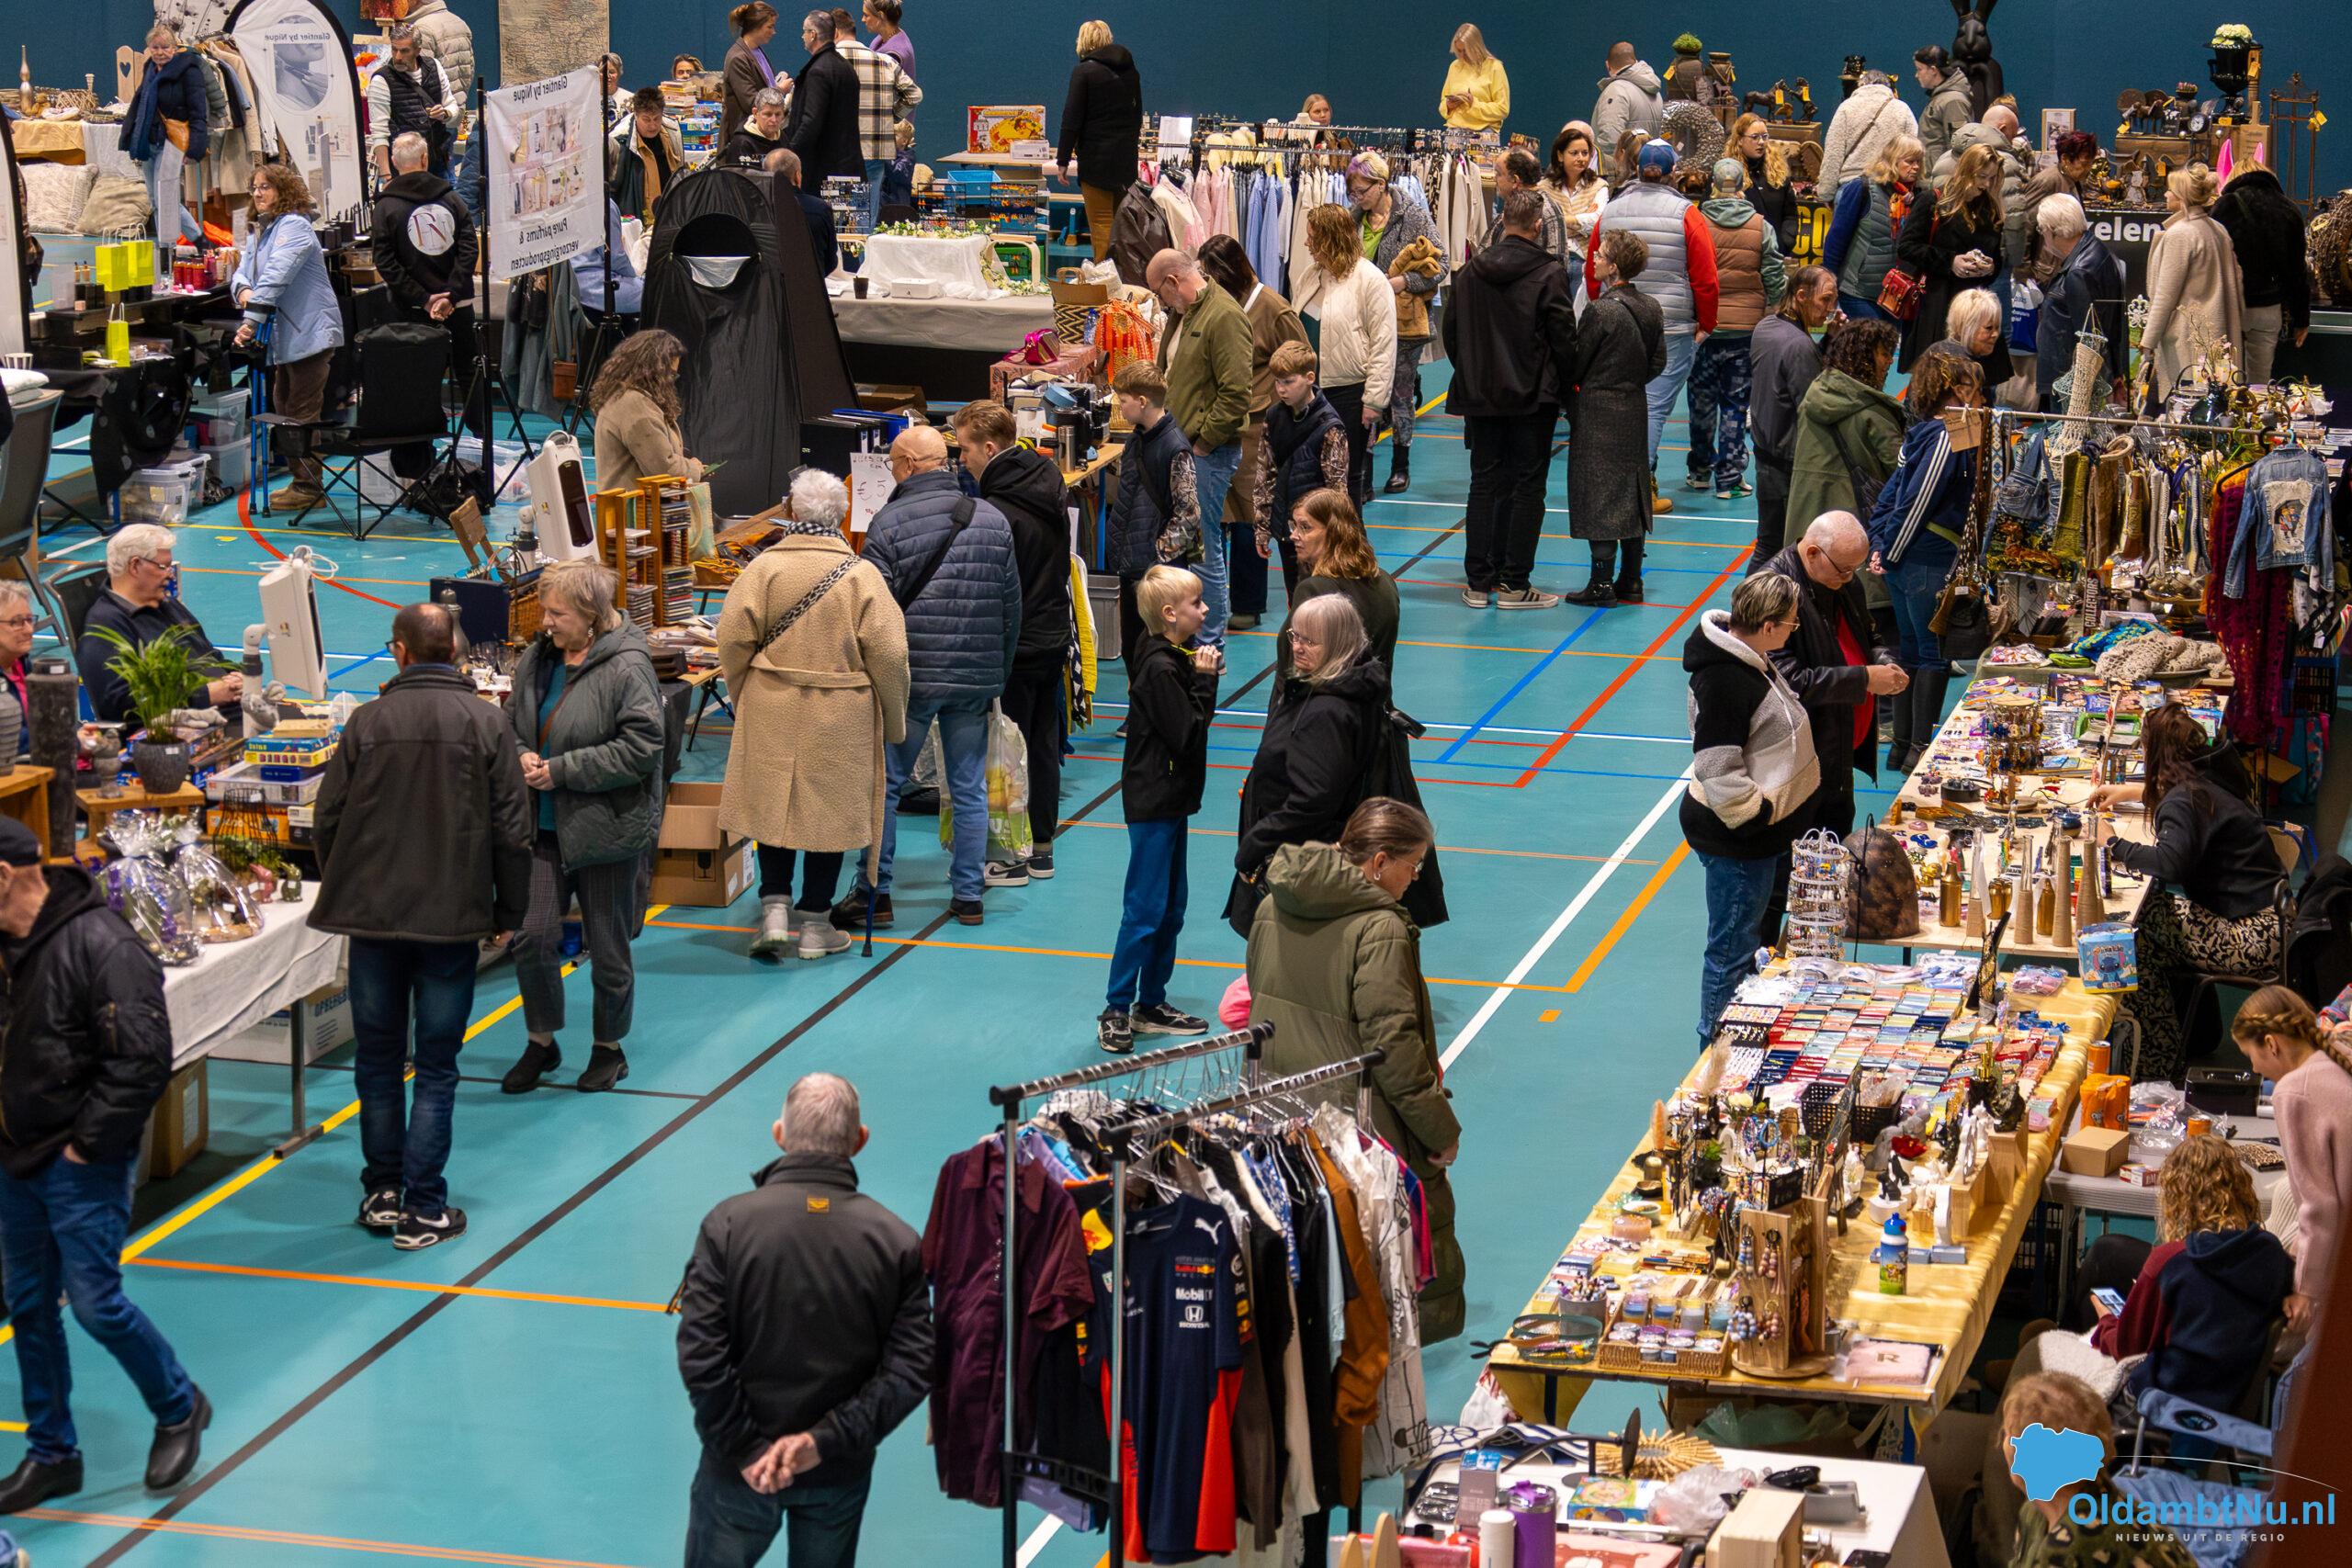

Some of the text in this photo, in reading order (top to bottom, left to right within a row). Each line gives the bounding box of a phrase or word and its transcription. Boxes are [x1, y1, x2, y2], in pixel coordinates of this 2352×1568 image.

[2086, 216, 2162, 243] elen
[2085, 577, 2099, 627] COLLECTORS
[258, 752, 298, 764] BINGO
[1175, 1287, 1205, 1301] Mobil
[1178, 1321, 1211, 1329] HONDA
[1876, 1352, 1901, 1364] R
